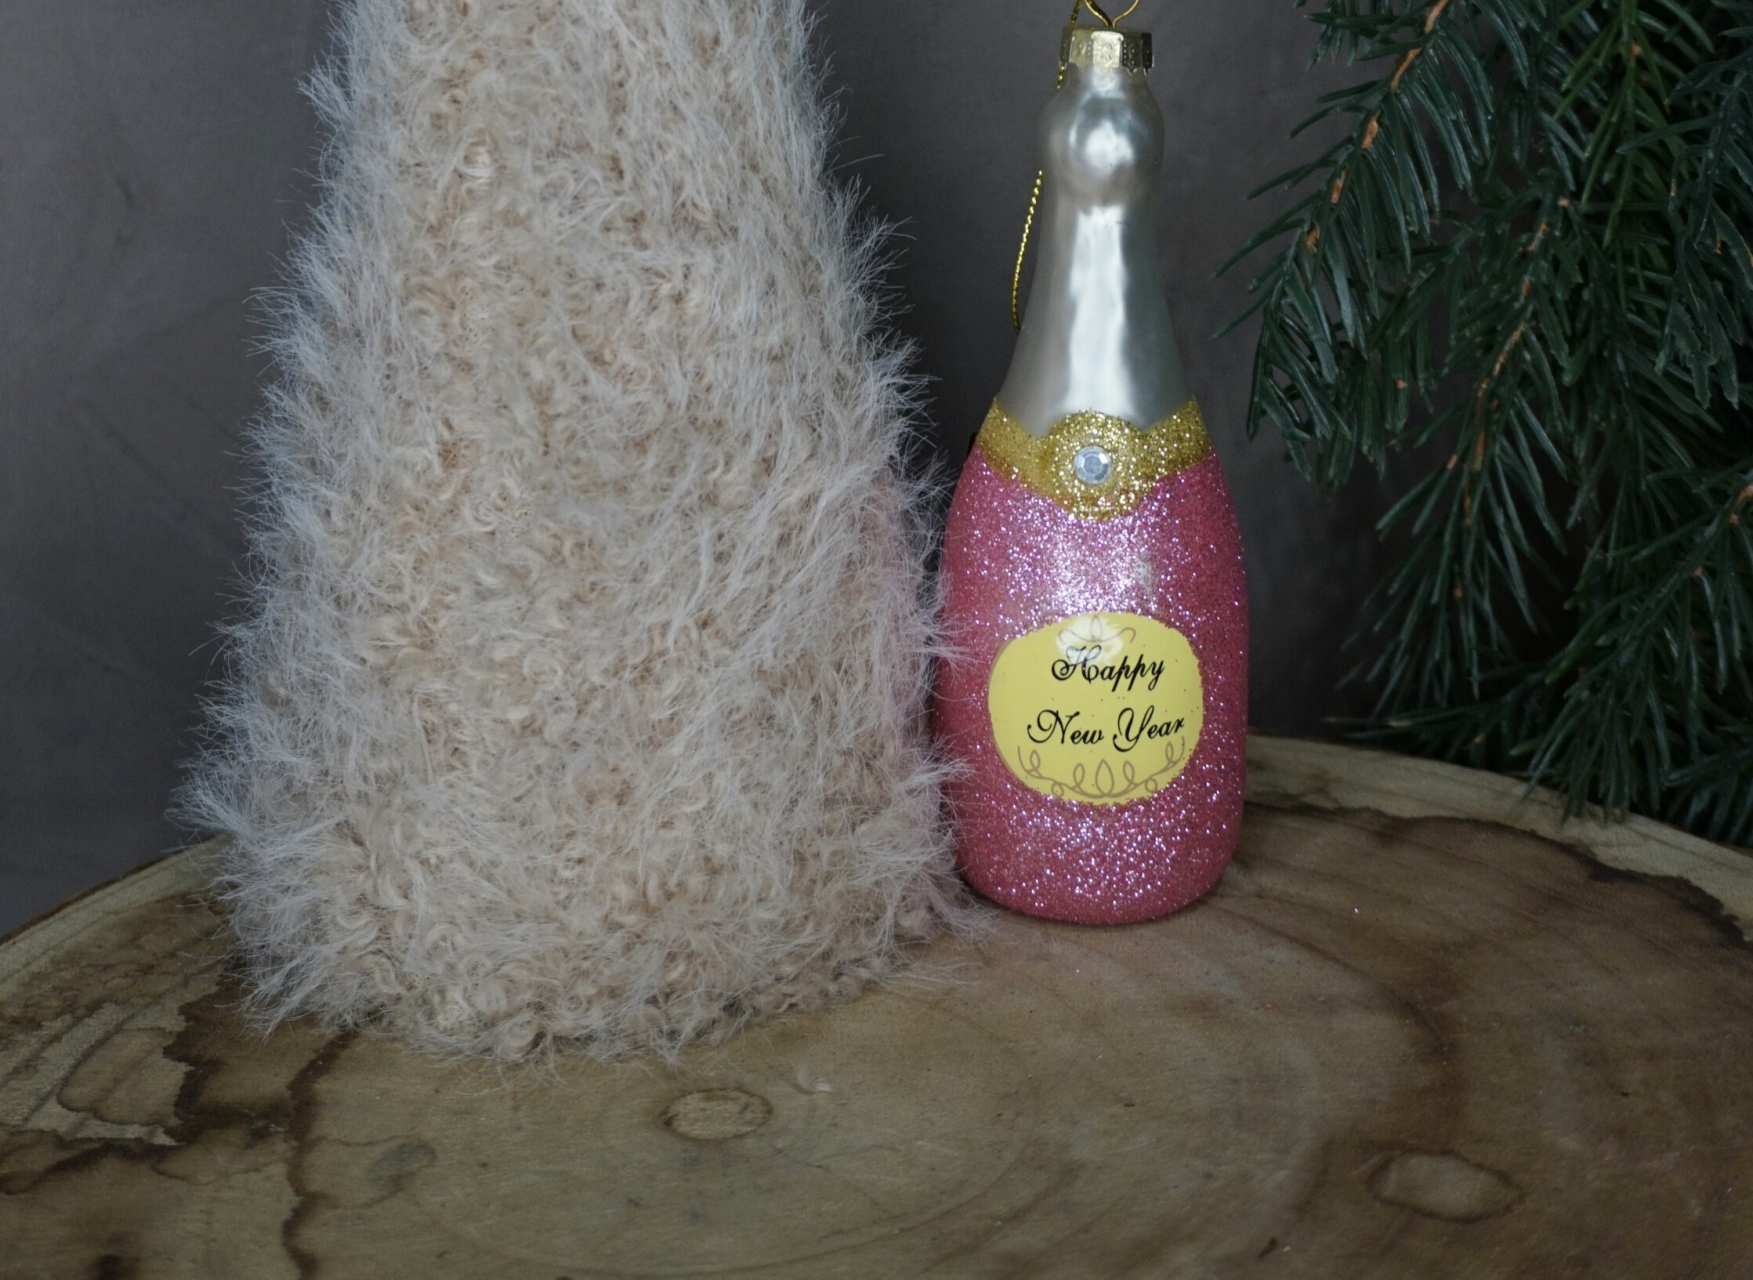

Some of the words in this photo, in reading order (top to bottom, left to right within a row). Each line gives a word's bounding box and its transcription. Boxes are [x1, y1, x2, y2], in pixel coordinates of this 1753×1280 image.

[1051, 645, 1165, 692] Happy
[1027, 709, 1104, 744] New
[1112, 705, 1185, 752] Year
